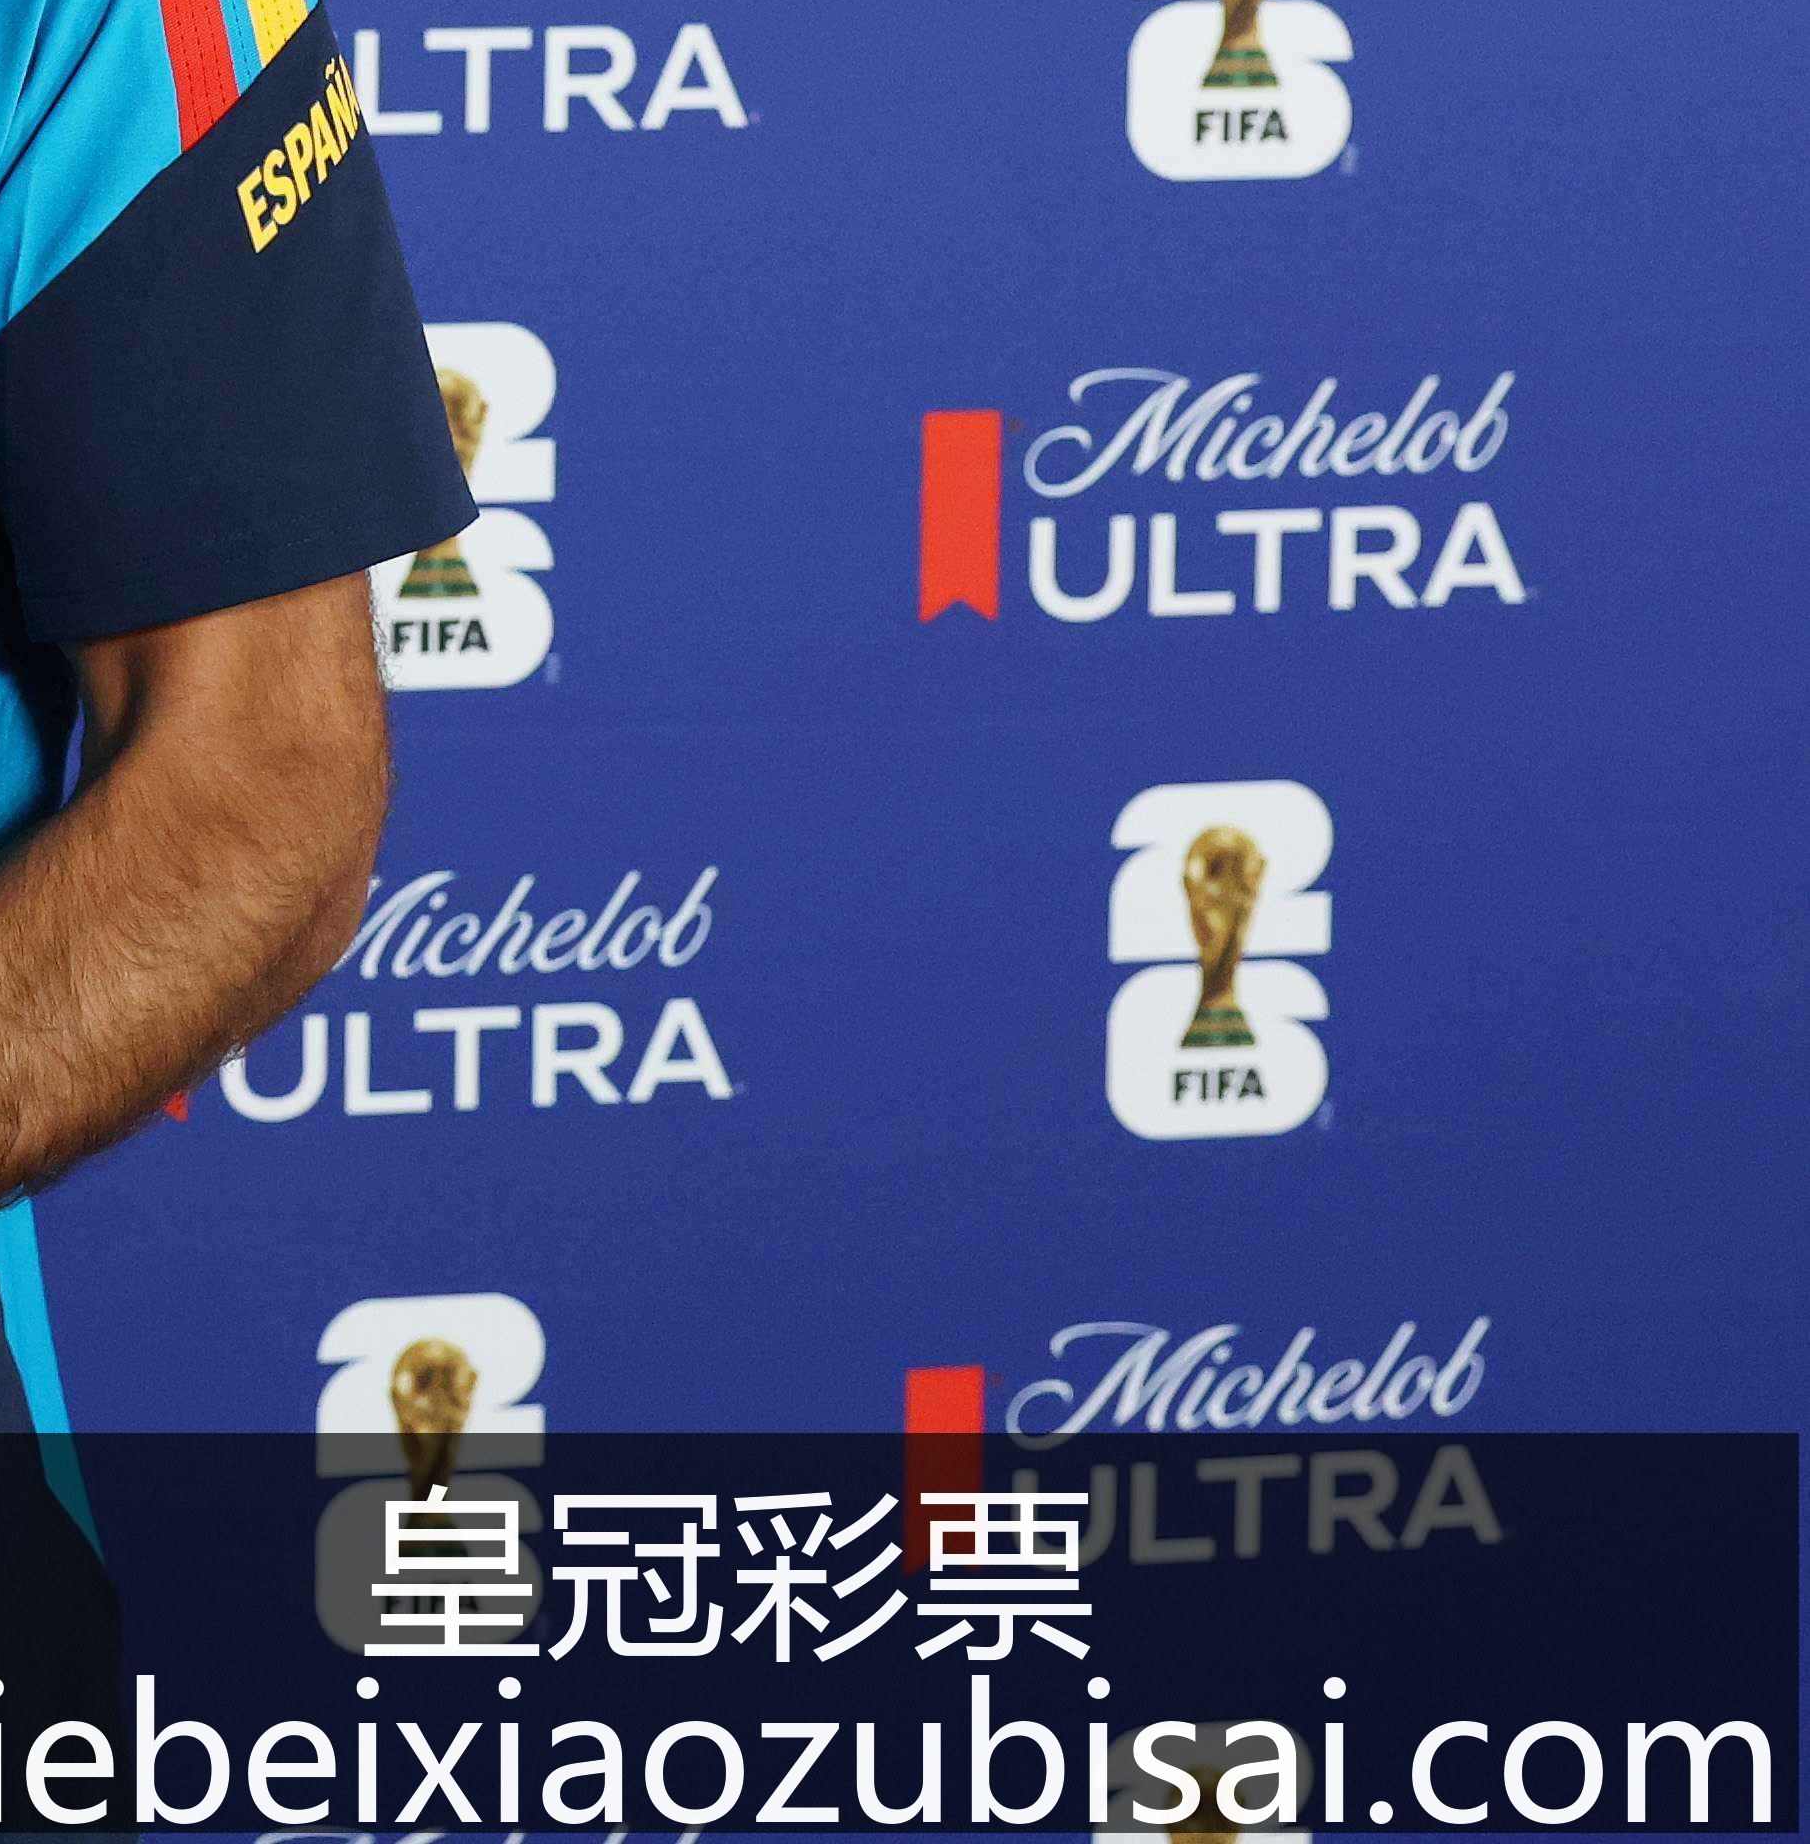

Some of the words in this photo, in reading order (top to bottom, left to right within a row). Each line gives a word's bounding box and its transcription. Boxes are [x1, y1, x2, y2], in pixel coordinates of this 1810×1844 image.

[336, 24, 747, 136] LTRA
[1195, 110, 1287, 142] FIFA
[1026, 369, 1513, 496] Michelob
[1030, 503, 1525, 621] ULTRA
[392, 619, 488, 653] FIFA
[220, 999, 732, 1121] ULTRA
[1174, 1068, 1264, 1101] FIFA
[1008, 1318, 1488, 1449] Michelob
